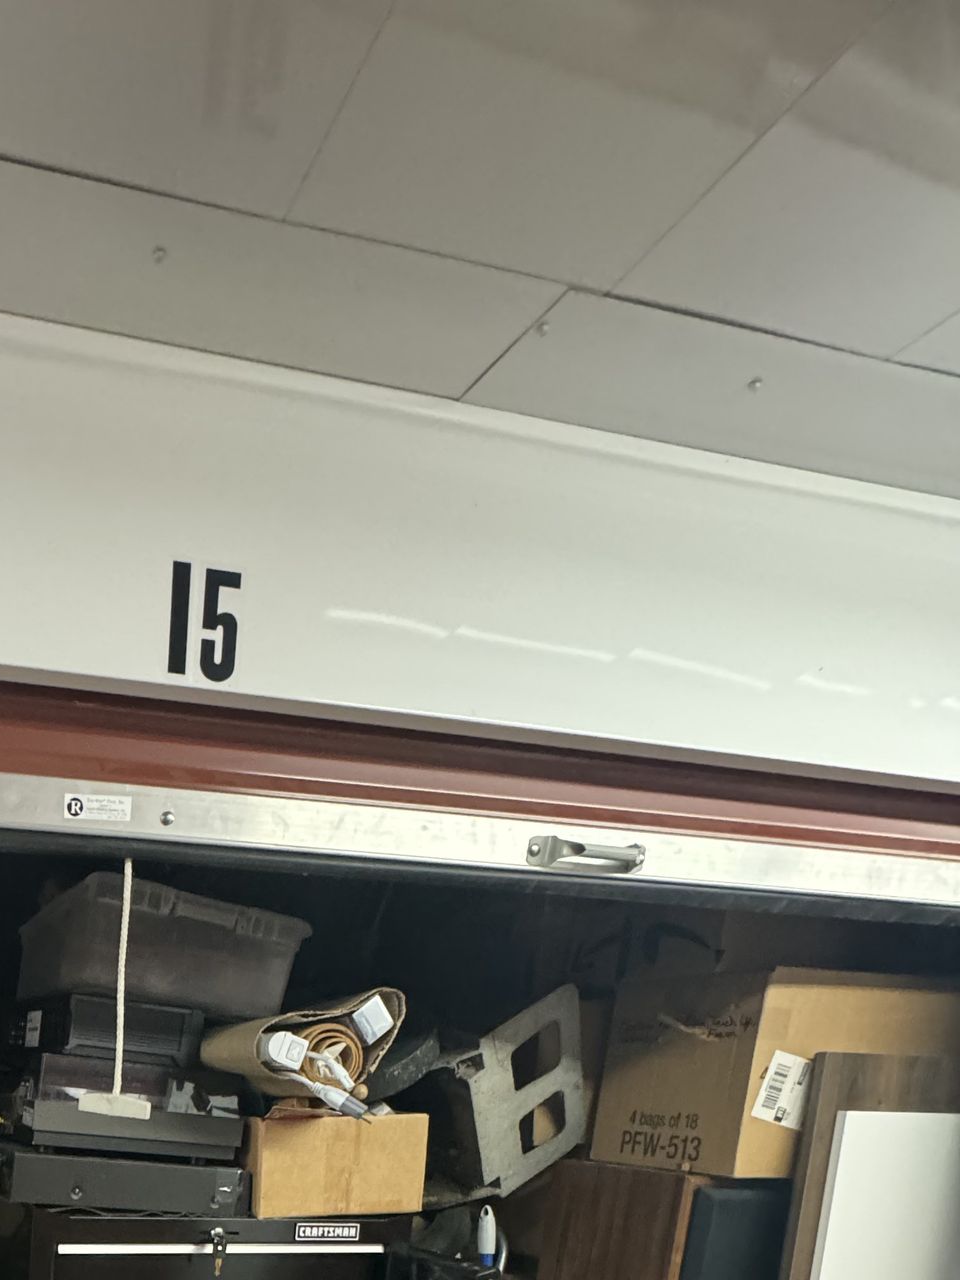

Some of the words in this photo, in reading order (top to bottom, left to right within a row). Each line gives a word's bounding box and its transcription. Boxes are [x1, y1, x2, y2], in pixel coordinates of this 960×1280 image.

[167, 560, 242, 682] 15
[630, 1109, 637, 1124] 4
[640, 1110, 665, 1129] bags
[669, 1111, 681, 1128] of
[685, 1113, 699, 1130] 18
[620, 1130, 701, 1161] PFW-513
[299, 1226, 357, 1237] CRAFTSMAN
